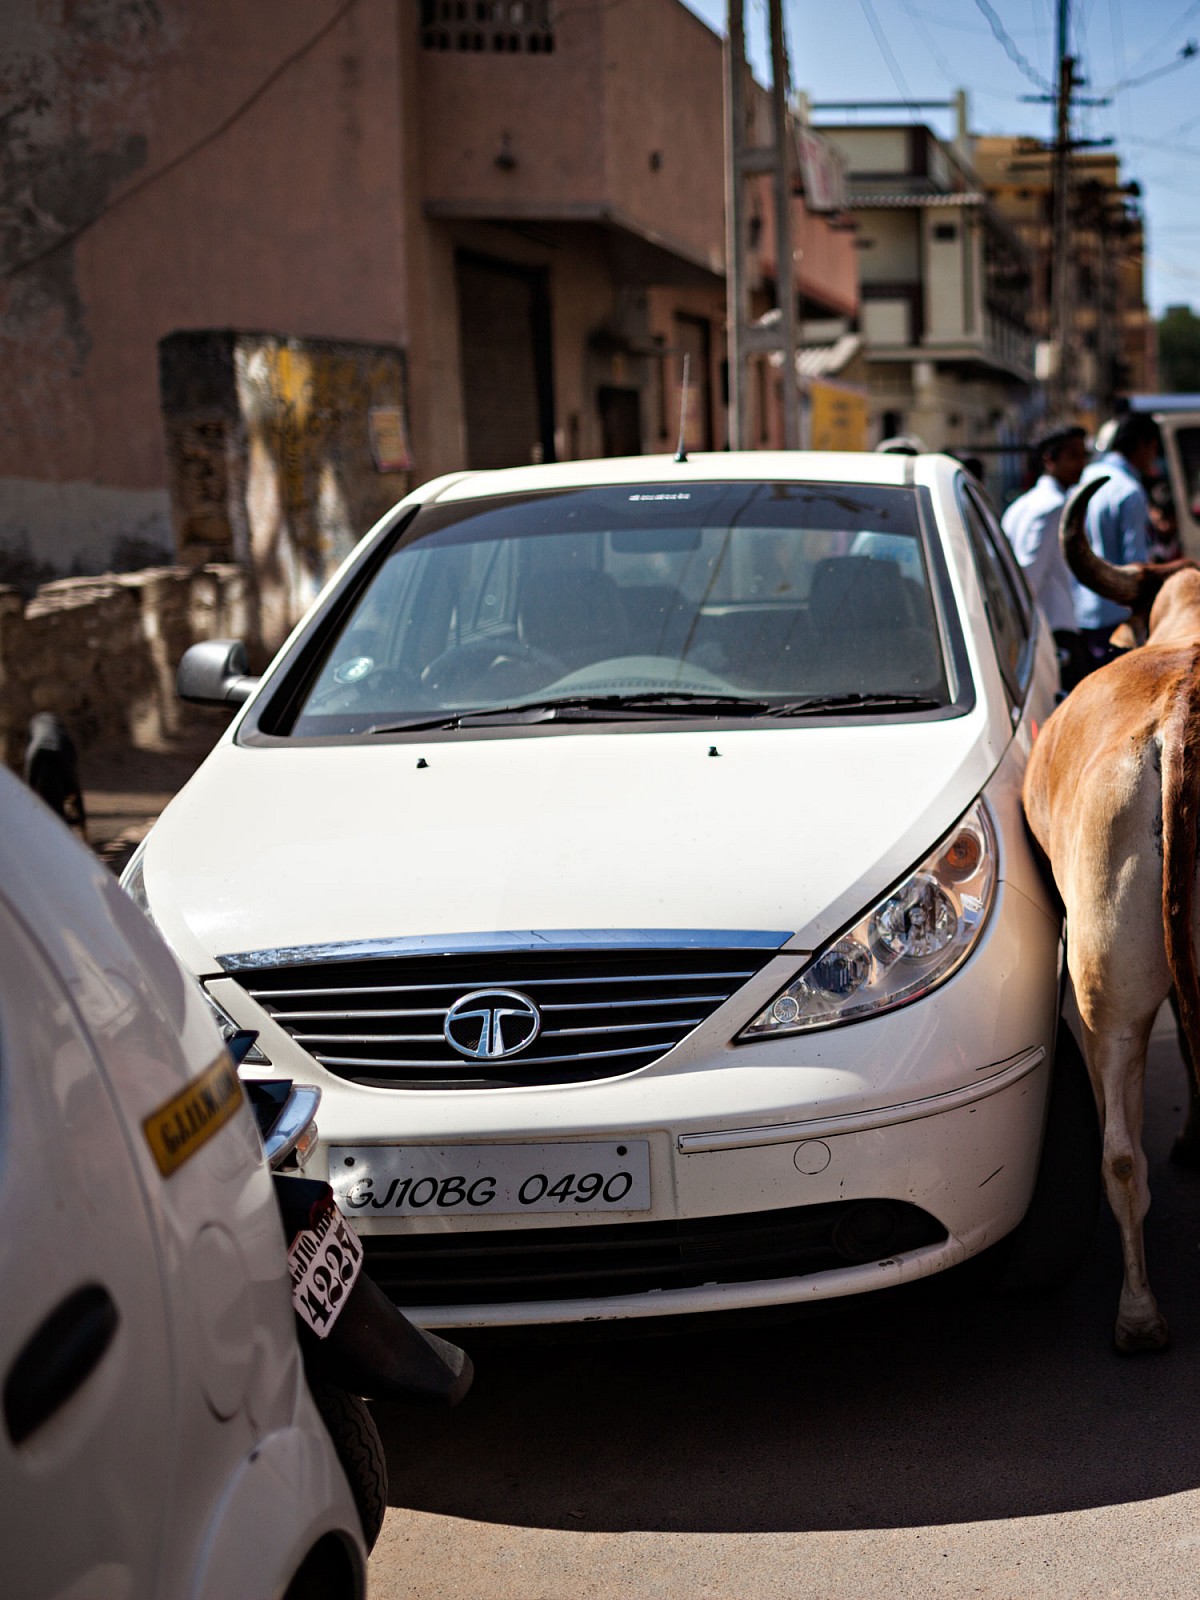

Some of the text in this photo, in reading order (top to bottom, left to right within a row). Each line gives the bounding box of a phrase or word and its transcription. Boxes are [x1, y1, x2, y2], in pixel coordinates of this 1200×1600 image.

[346, 1171, 633, 1209] GJ10BG 0490
[300, 1220, 360, 1327] 4227
